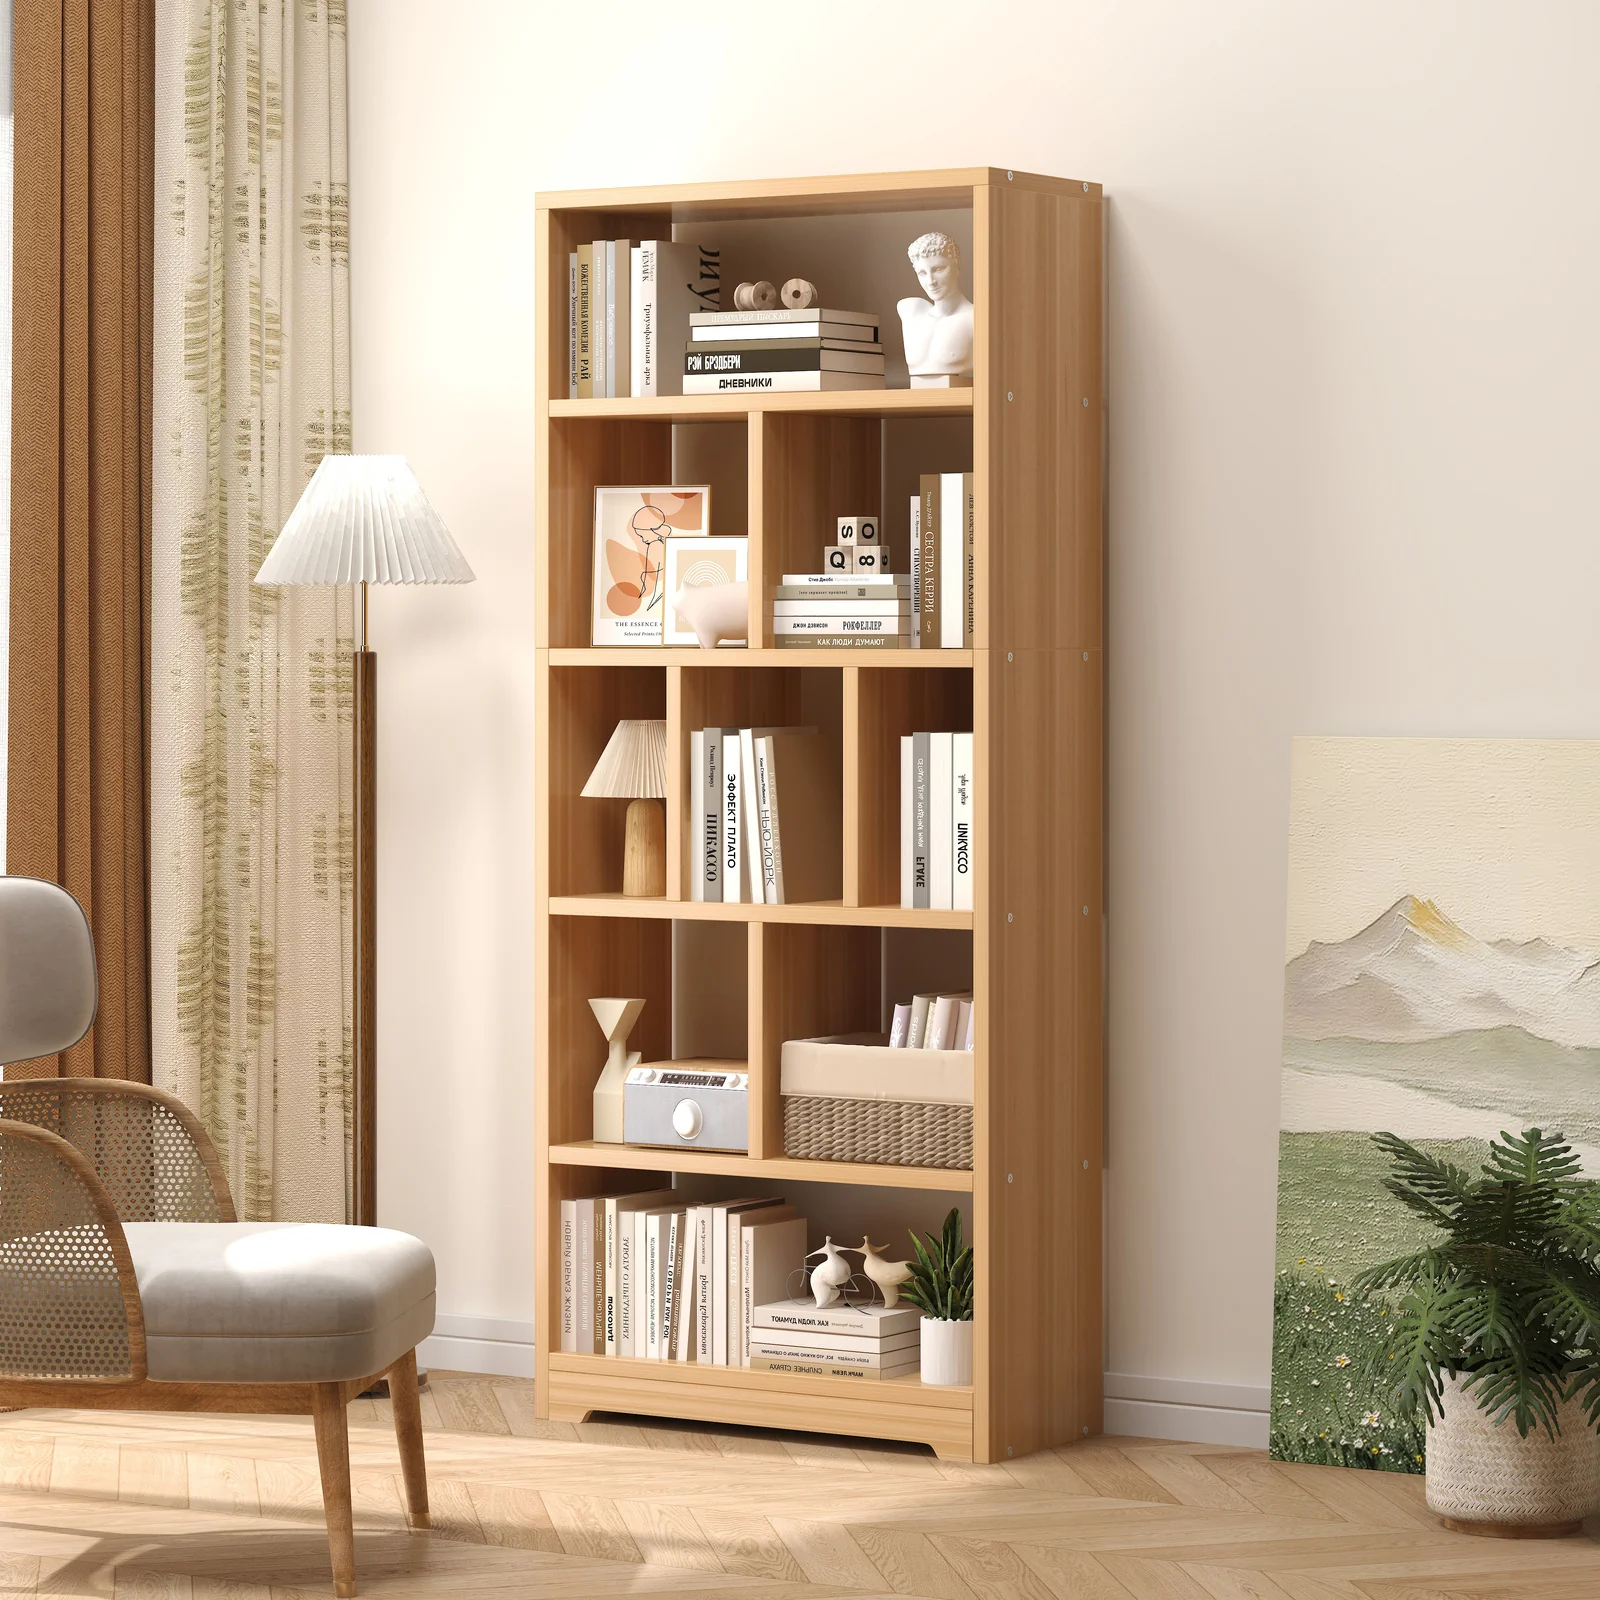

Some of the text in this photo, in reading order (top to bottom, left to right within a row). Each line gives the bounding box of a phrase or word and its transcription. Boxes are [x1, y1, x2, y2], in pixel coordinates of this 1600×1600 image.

[580, 264, 591, 380] БОЖЕСТВЕННАЯ КОМЕДИЯ РАЙ
[644, 303, 652, 364] Триумфальная
[688, 353, 740, 370] РЭЙ БРЭДБЕРИ
[718, 378, 772, 389] ДНЕВНИКИ
[841, 525, 853, 539] S
[830, 551, 846, 569] Q
[858, 554, 875, 566] 8
[924, 531, 934, 574] СЕСТРА
[924, 578, 934, 613] КЕРРИ
[842, 621, 882, 631] РОКФЕЛЛЕР
[832, 638, 852, 646] ЛЮДИ
[854, 638, 885, 646] ДУМАЮТ
[727, 774, 736, 868] ЭФФЕКТ ПЛАТО
[706, 814, 717, 882] ПИКАССО
[761, 810, 775, 886] НЬЮ-ЙОРК
